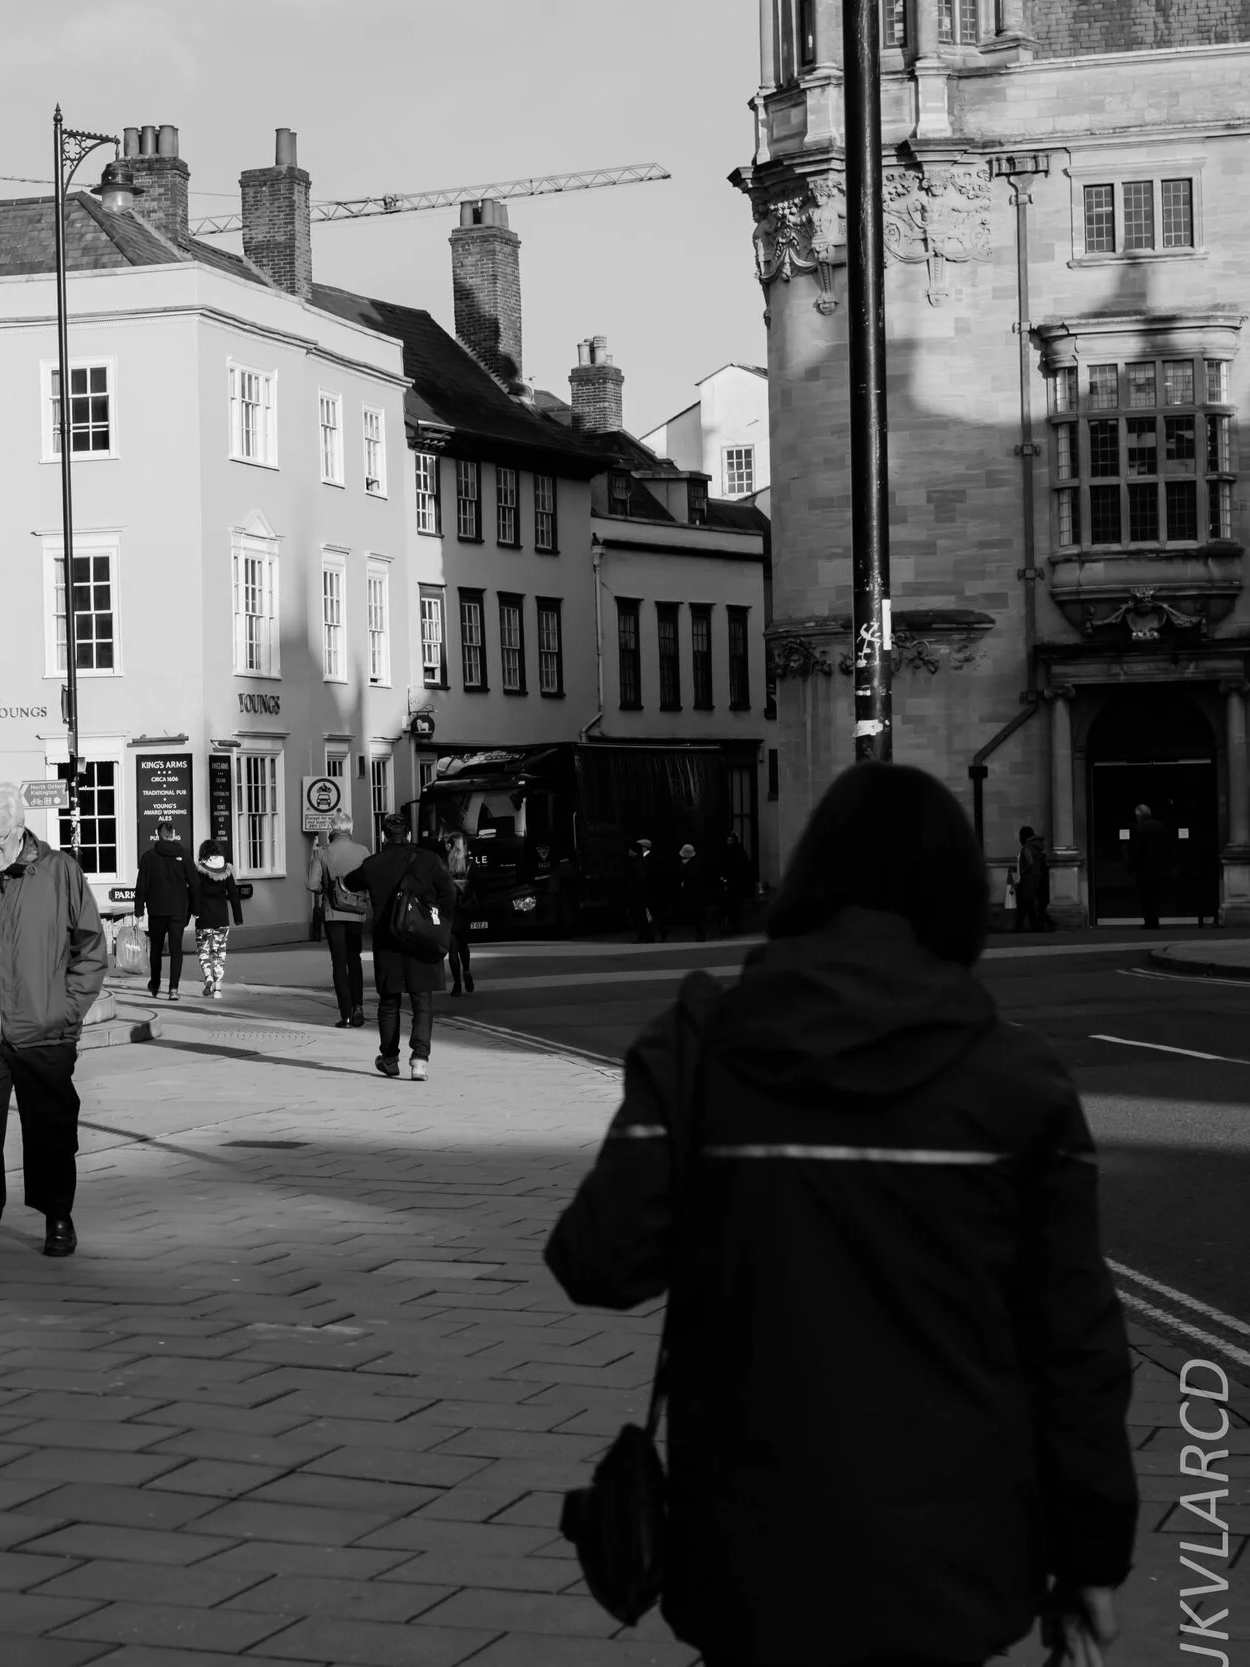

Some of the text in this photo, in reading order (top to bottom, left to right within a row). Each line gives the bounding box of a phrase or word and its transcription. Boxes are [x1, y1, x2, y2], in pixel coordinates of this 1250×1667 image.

[237, 692, 281, 715] YOUNGS
[141, 760, 188, 770] KING'S ARMS
